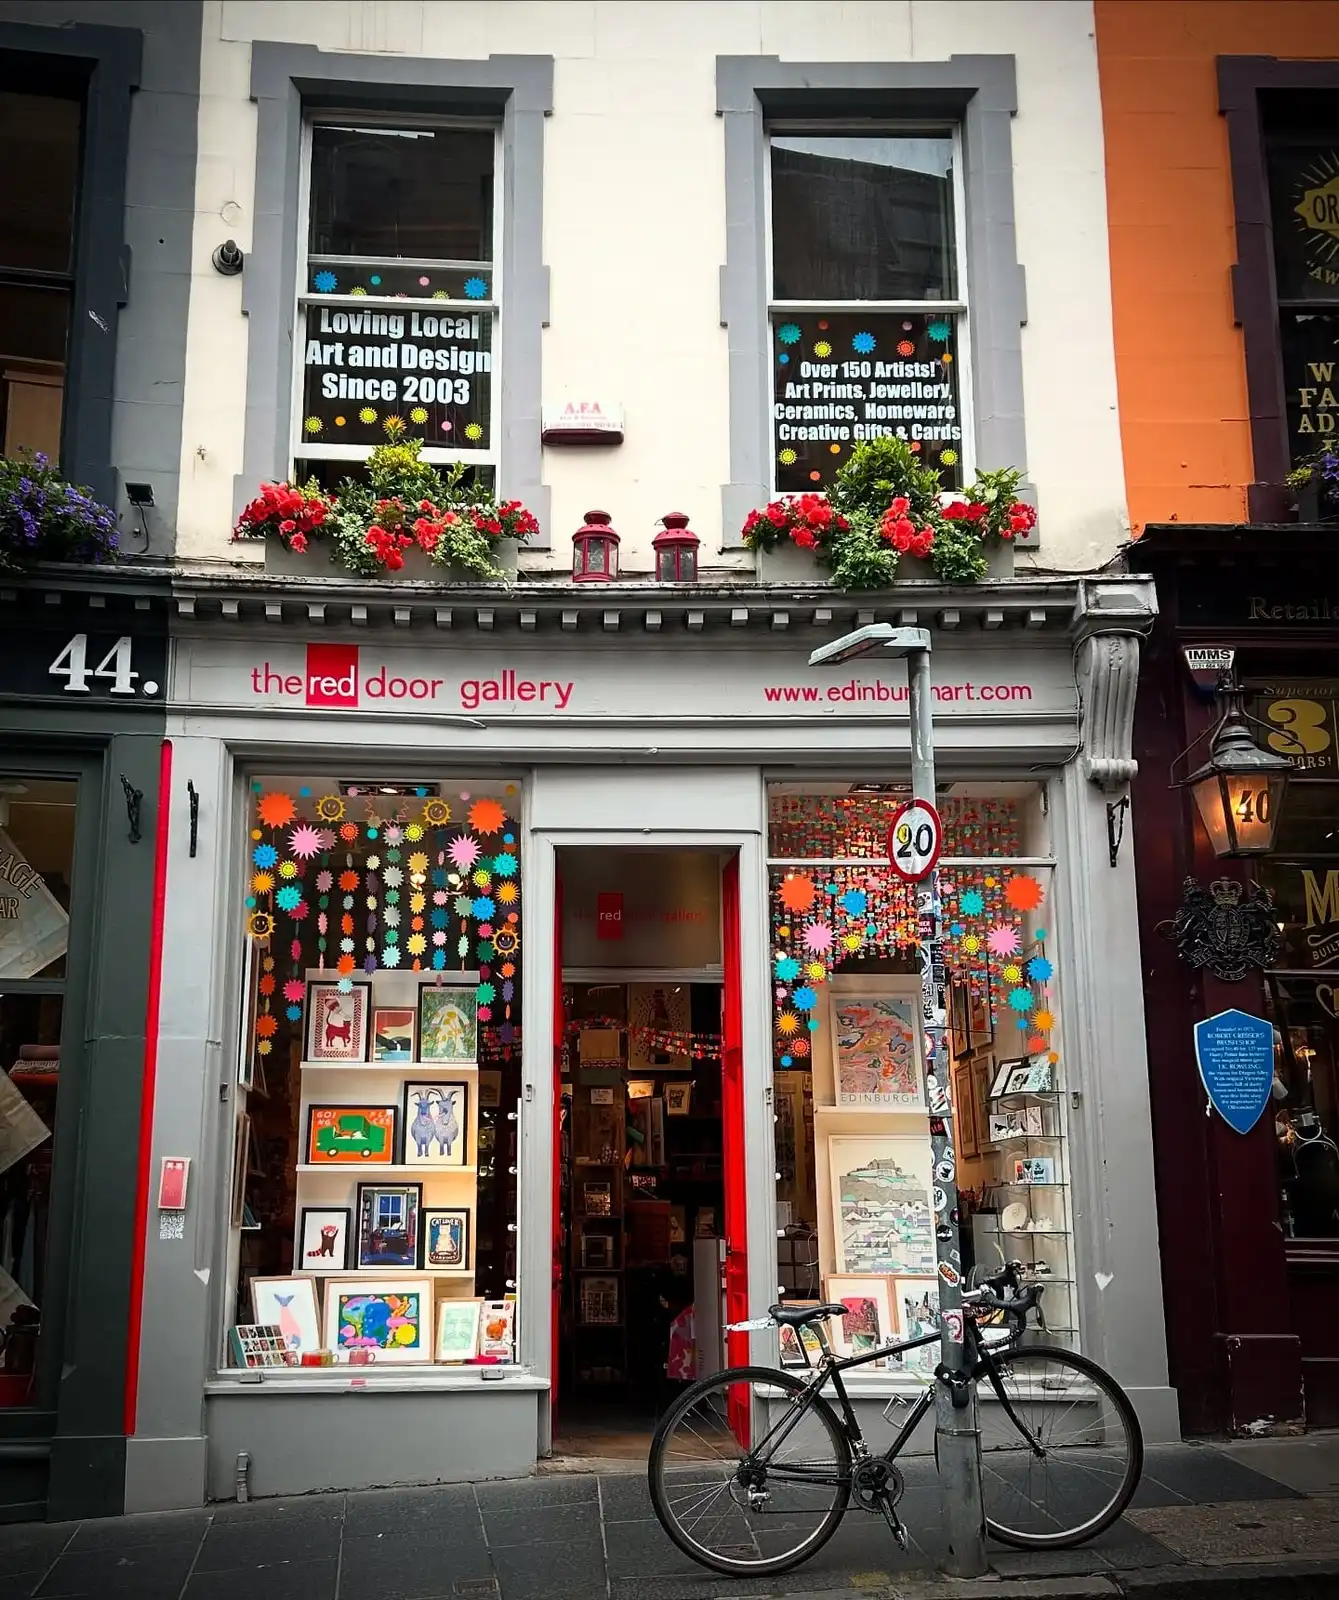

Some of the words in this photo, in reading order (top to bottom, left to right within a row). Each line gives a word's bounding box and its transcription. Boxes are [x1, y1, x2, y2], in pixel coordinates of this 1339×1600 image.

[320, 309, 404, 339] Loving
[411, 312, 479, 340] Local
[305, 340, 345, 367] Art
[348, 343, 398, 369] and
[401, 344, 491, 375] Design
[800, 361, 838, 378] Over
[841, 361, 870, 378] 150
[874, 361, 936, 378] Artists!
[321, 372, 397, 401] Since
[402, 376, 470, 405] 2003
[785, 382, 810, 399] Art
[813, 382, 867, 400] Prints,
[869, 382, 953, 400] Jewellery,
[774, 403, 859, 421] Ceramics,
[865, 404, 956, 419] Homeware
[779, 423, 850, 440] Creative
[853, 423, 892, 440] Gifts
[896, 424, 908, 440] &
[911, 423, 961, 440] Cards
[1297, 414, 1339, 433] AD
[1189, 650, 1231, 660] IMMS
[252, 663, 302, 694] the
[309, 665, 355, 698] red
[365, 666, 443, 699] door
[460, 669, 574, 708] gallery
[764, 680, 1032, 701] www.edinburart.com
[1267, 698, 1331, 754] 3
[1236, 790, 1271, 823] 40
[896, 823, 934, 858] 20
[599, 909, 621, 921] red
[841, 1093, 919, 1103] EDINBURGH
